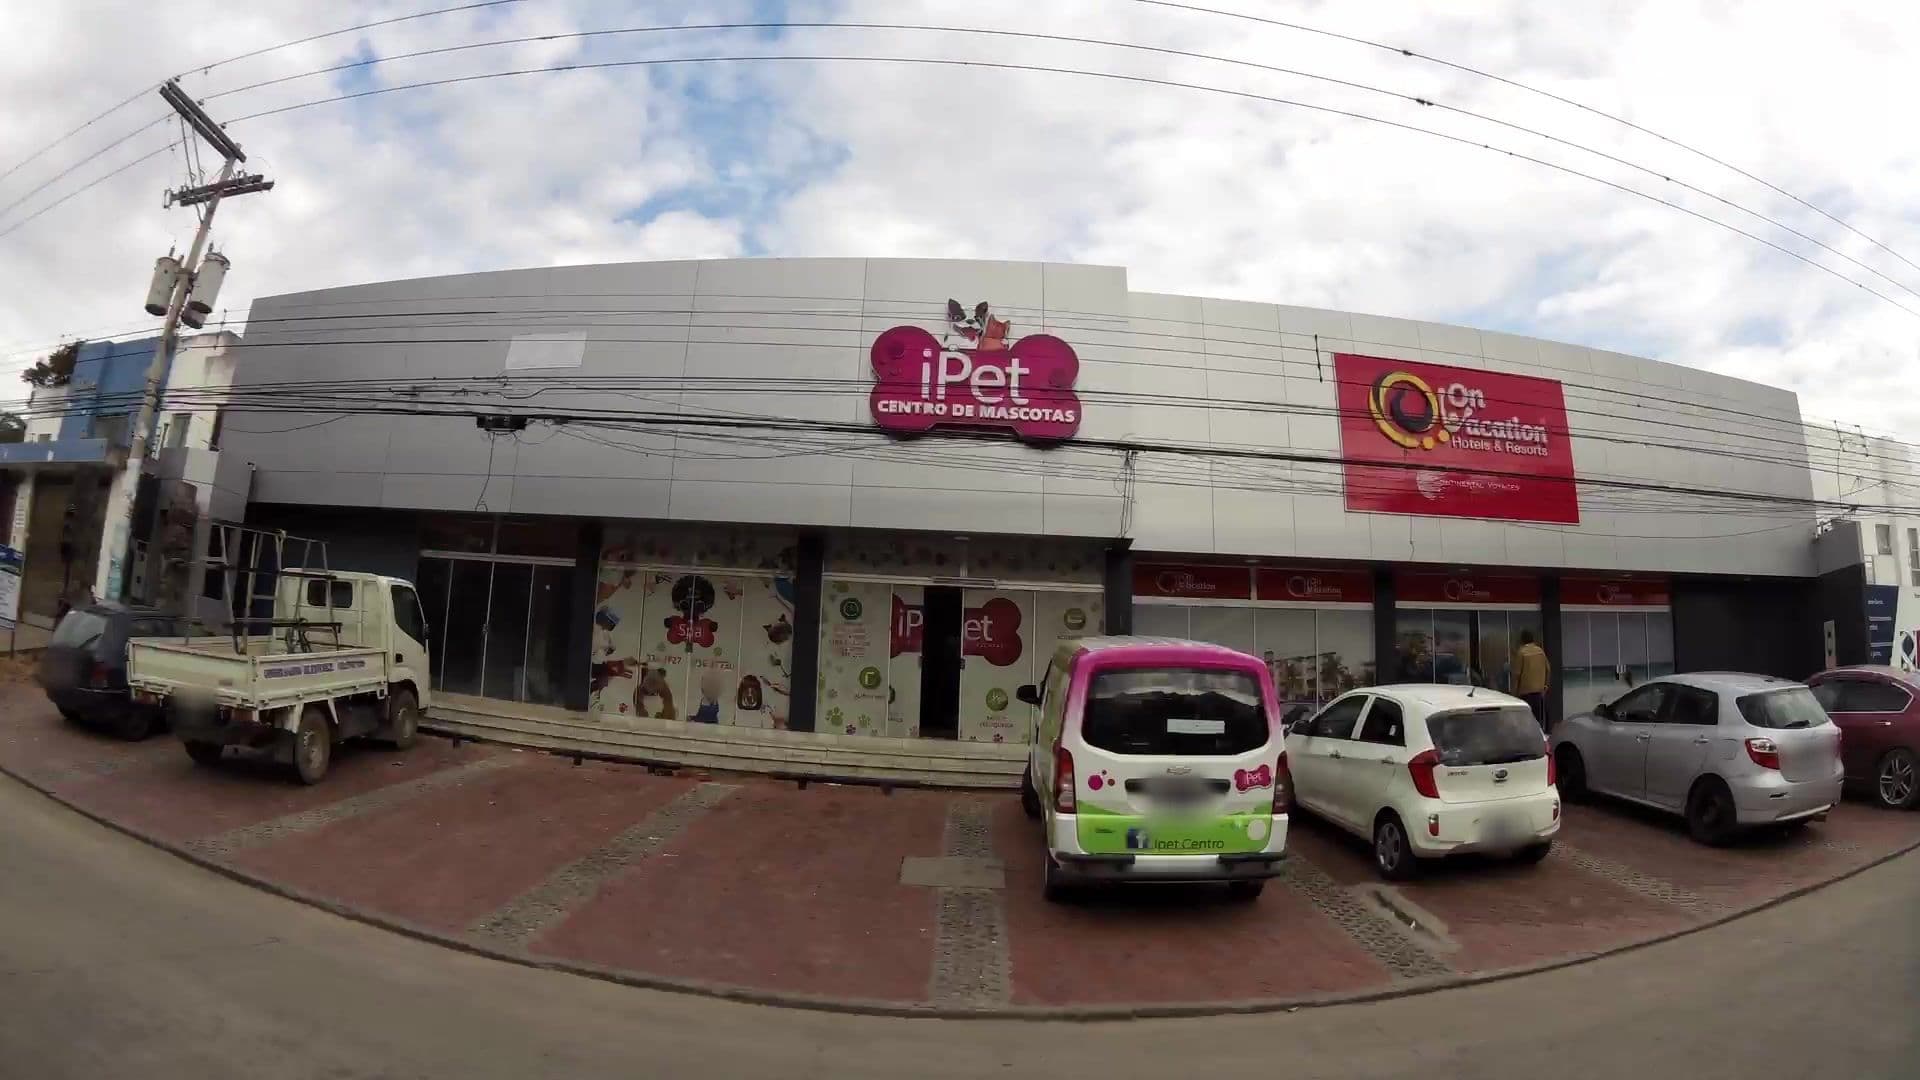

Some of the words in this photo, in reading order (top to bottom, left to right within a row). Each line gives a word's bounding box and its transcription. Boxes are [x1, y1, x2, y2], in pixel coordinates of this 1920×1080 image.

[921, 348, 1030, 405] iPet
[1447, 383, 1486, 409] On
[877, 400, 948, 416] CENTRO
[951, 404, 975, 418] DE
[979, 405, 1076, 424] MASCOTAS
[1444, 410, 1549, 445] Vacation
[1451, 436, 1491, 451] Hotels
[1494, 440, 1503, 453] &
[1505, 441, 1549, 457] Resorts
[679, 624, 703, 643] Spa
